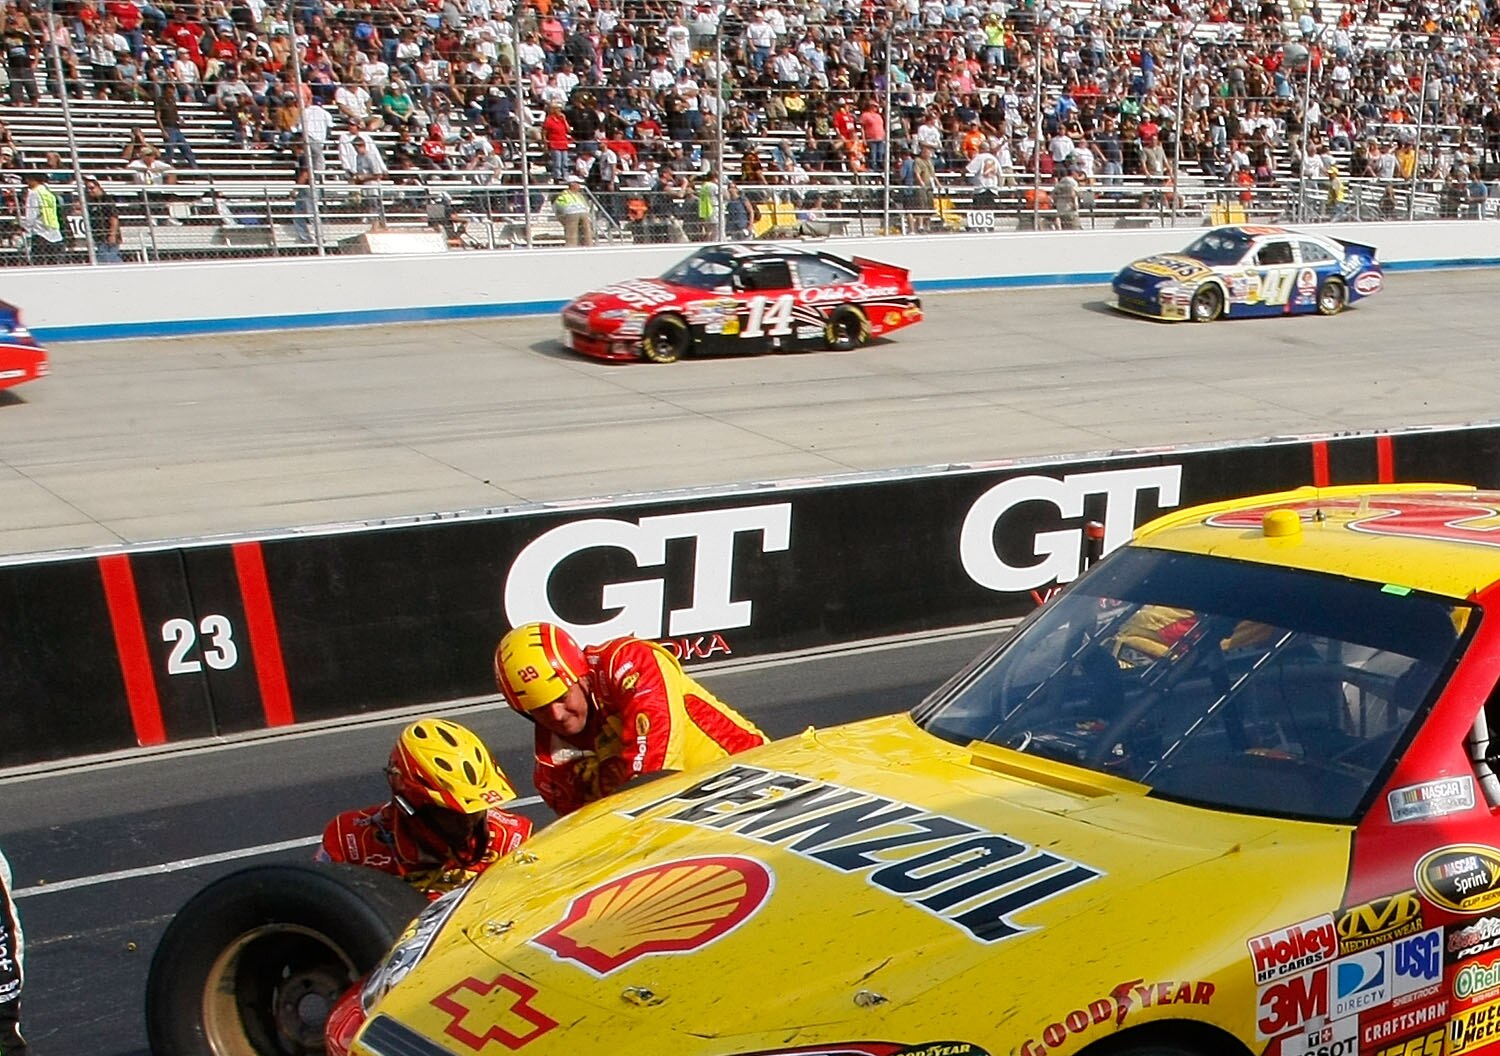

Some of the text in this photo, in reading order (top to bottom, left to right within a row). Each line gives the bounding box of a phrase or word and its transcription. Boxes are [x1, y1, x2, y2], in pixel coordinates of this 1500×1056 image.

[968, 211, 994, 226] 105
[1261, 268, 1297, 305] 47
[740, 294, 796, 338] 14
[960, 464, 1183, 592] GT
[505, 503, 792, 648] GT
[161, 613, 238, 676] 23
[517, 665, 540, 684] 29
[1421, 781, 1462, 801] NASCAR
[615, 765, 1107, 944] PENNZOIL
[1444, 855, 1479, 878] NASCAR
[1454, 869, 1489, 894] Sprint
[1250, 921, 1337, 972] Holley
[1340, 918, 1424, 955] MECHANIX WEAR
[1395, 931, 1440, 980] USG
[1257, 951, 1325, 983] HP CARBS
[1258, 967, 1328, 1035] 3M
[1336, 989, 1386, 1015] DIRECTV
[1365, 1002, 1447, 1043] CRAFTSMAN
